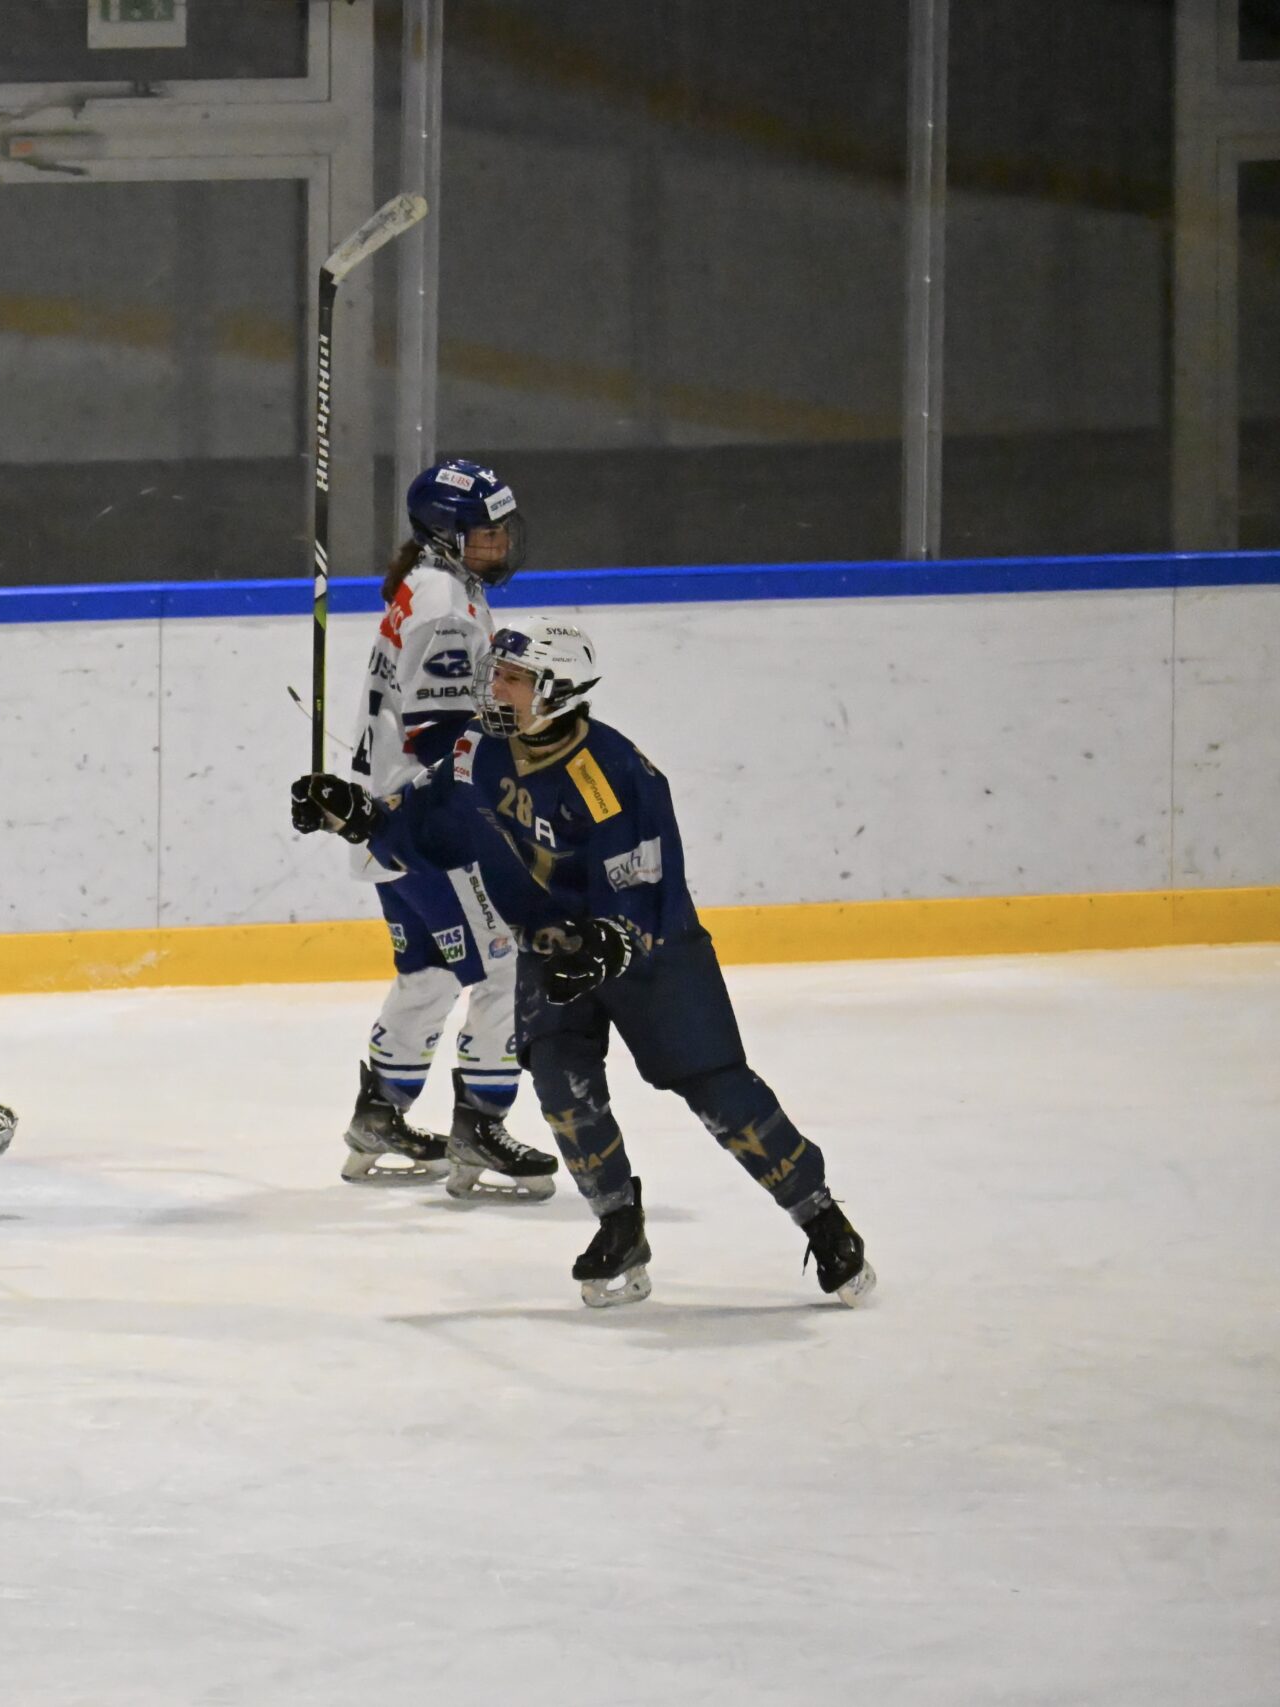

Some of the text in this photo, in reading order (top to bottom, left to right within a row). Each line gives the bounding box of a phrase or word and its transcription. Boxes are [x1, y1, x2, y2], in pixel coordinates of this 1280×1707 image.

[416, 686, 471, 700] SUBA
[496, 776, 534, 828] 28
[578, 763, 610, 815] PostFinance
[534, 816, 556, 848] A
[470, 875, 497, 930] SUBARU
